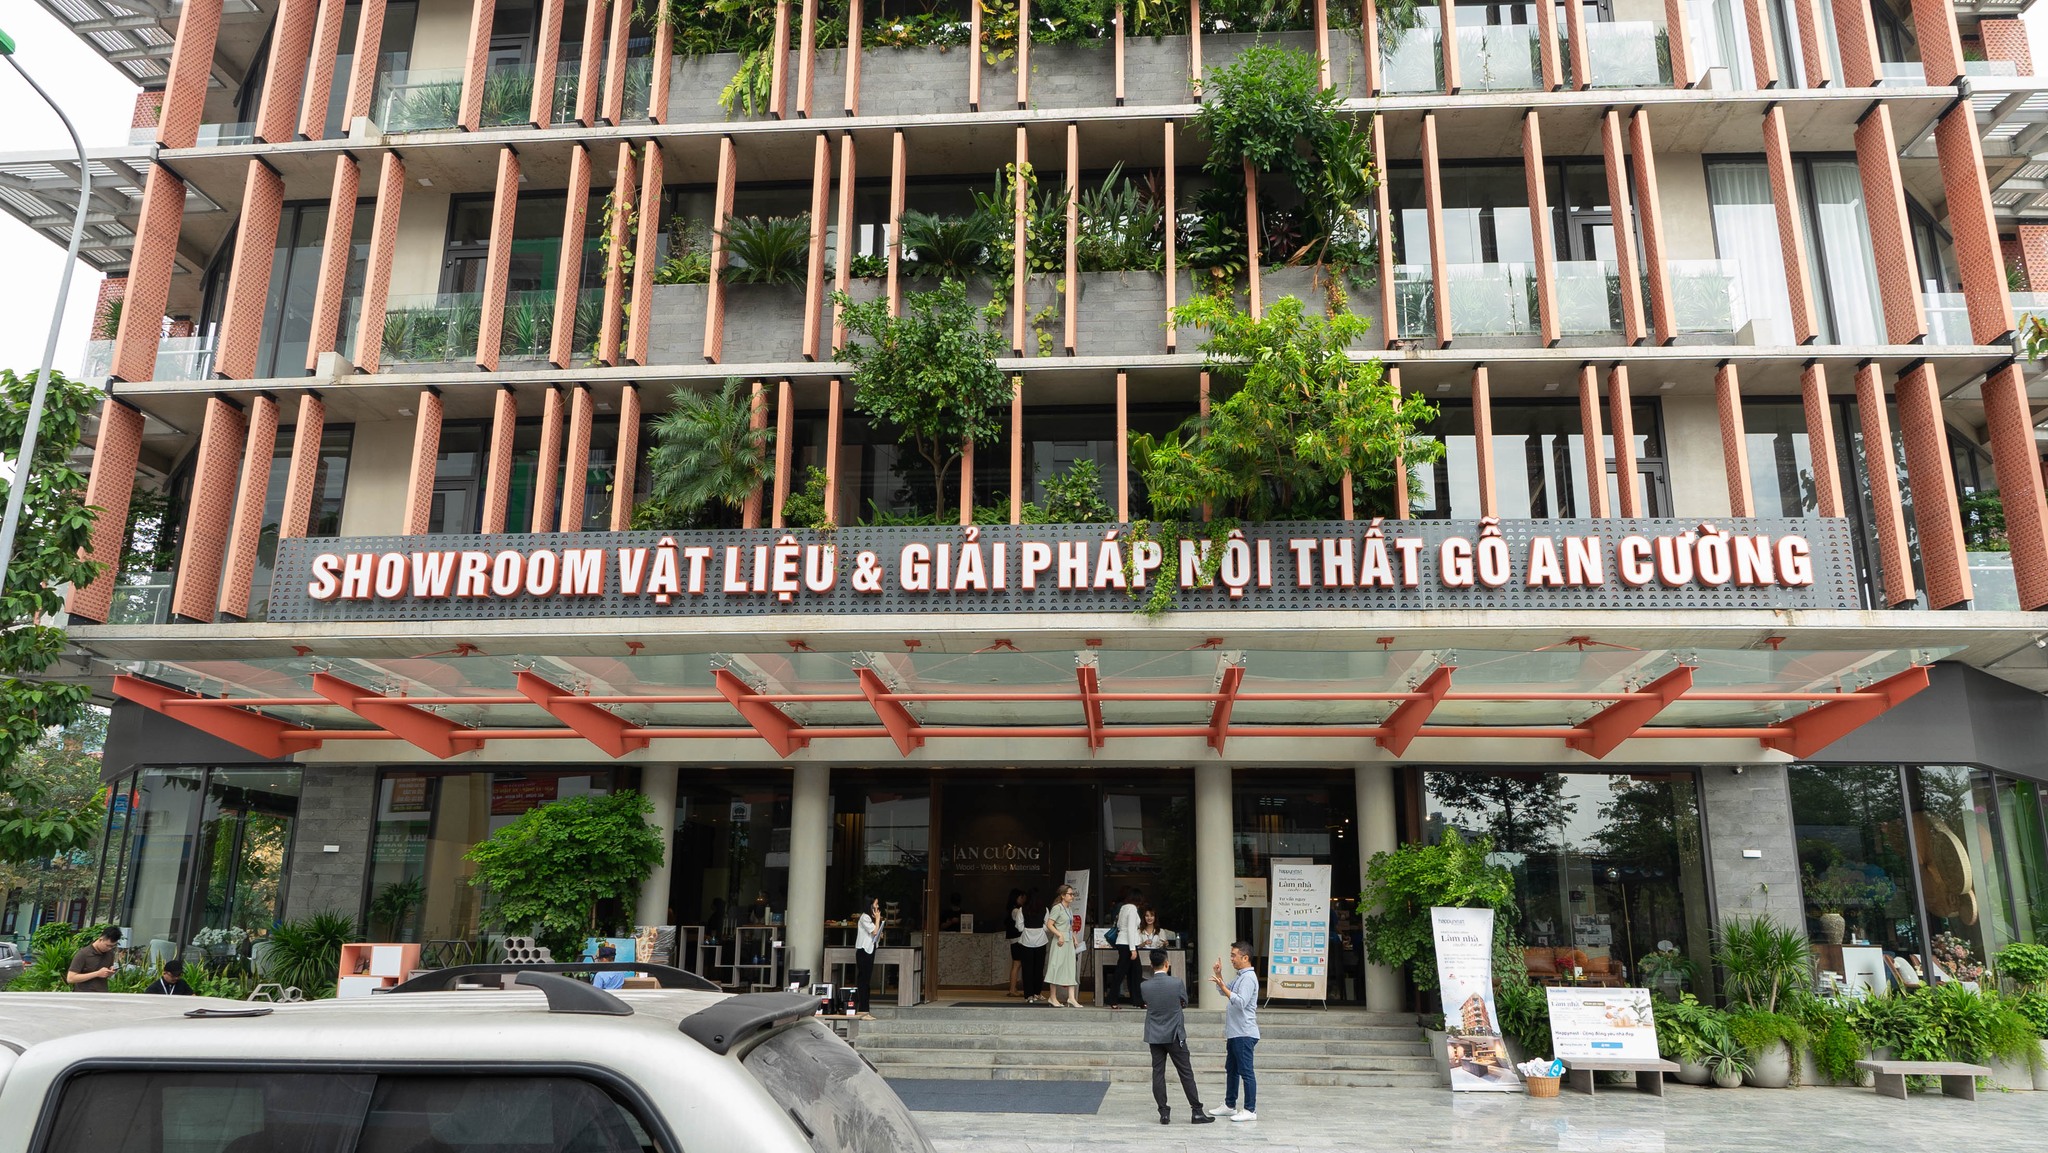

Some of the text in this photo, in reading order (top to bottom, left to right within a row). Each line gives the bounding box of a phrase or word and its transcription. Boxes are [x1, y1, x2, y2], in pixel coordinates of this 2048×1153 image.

[308, 515, 1814, 606] SHOWROOM VẬT LIỆU & GIẢI PHÁP NỘI THẤT GỖ AN CƯỜNG
[956, 843, 1040, 860] AN CƯỜNG
[956, 863, 975, 871] Wood
[1009, 863, 1041, 871] Materials
